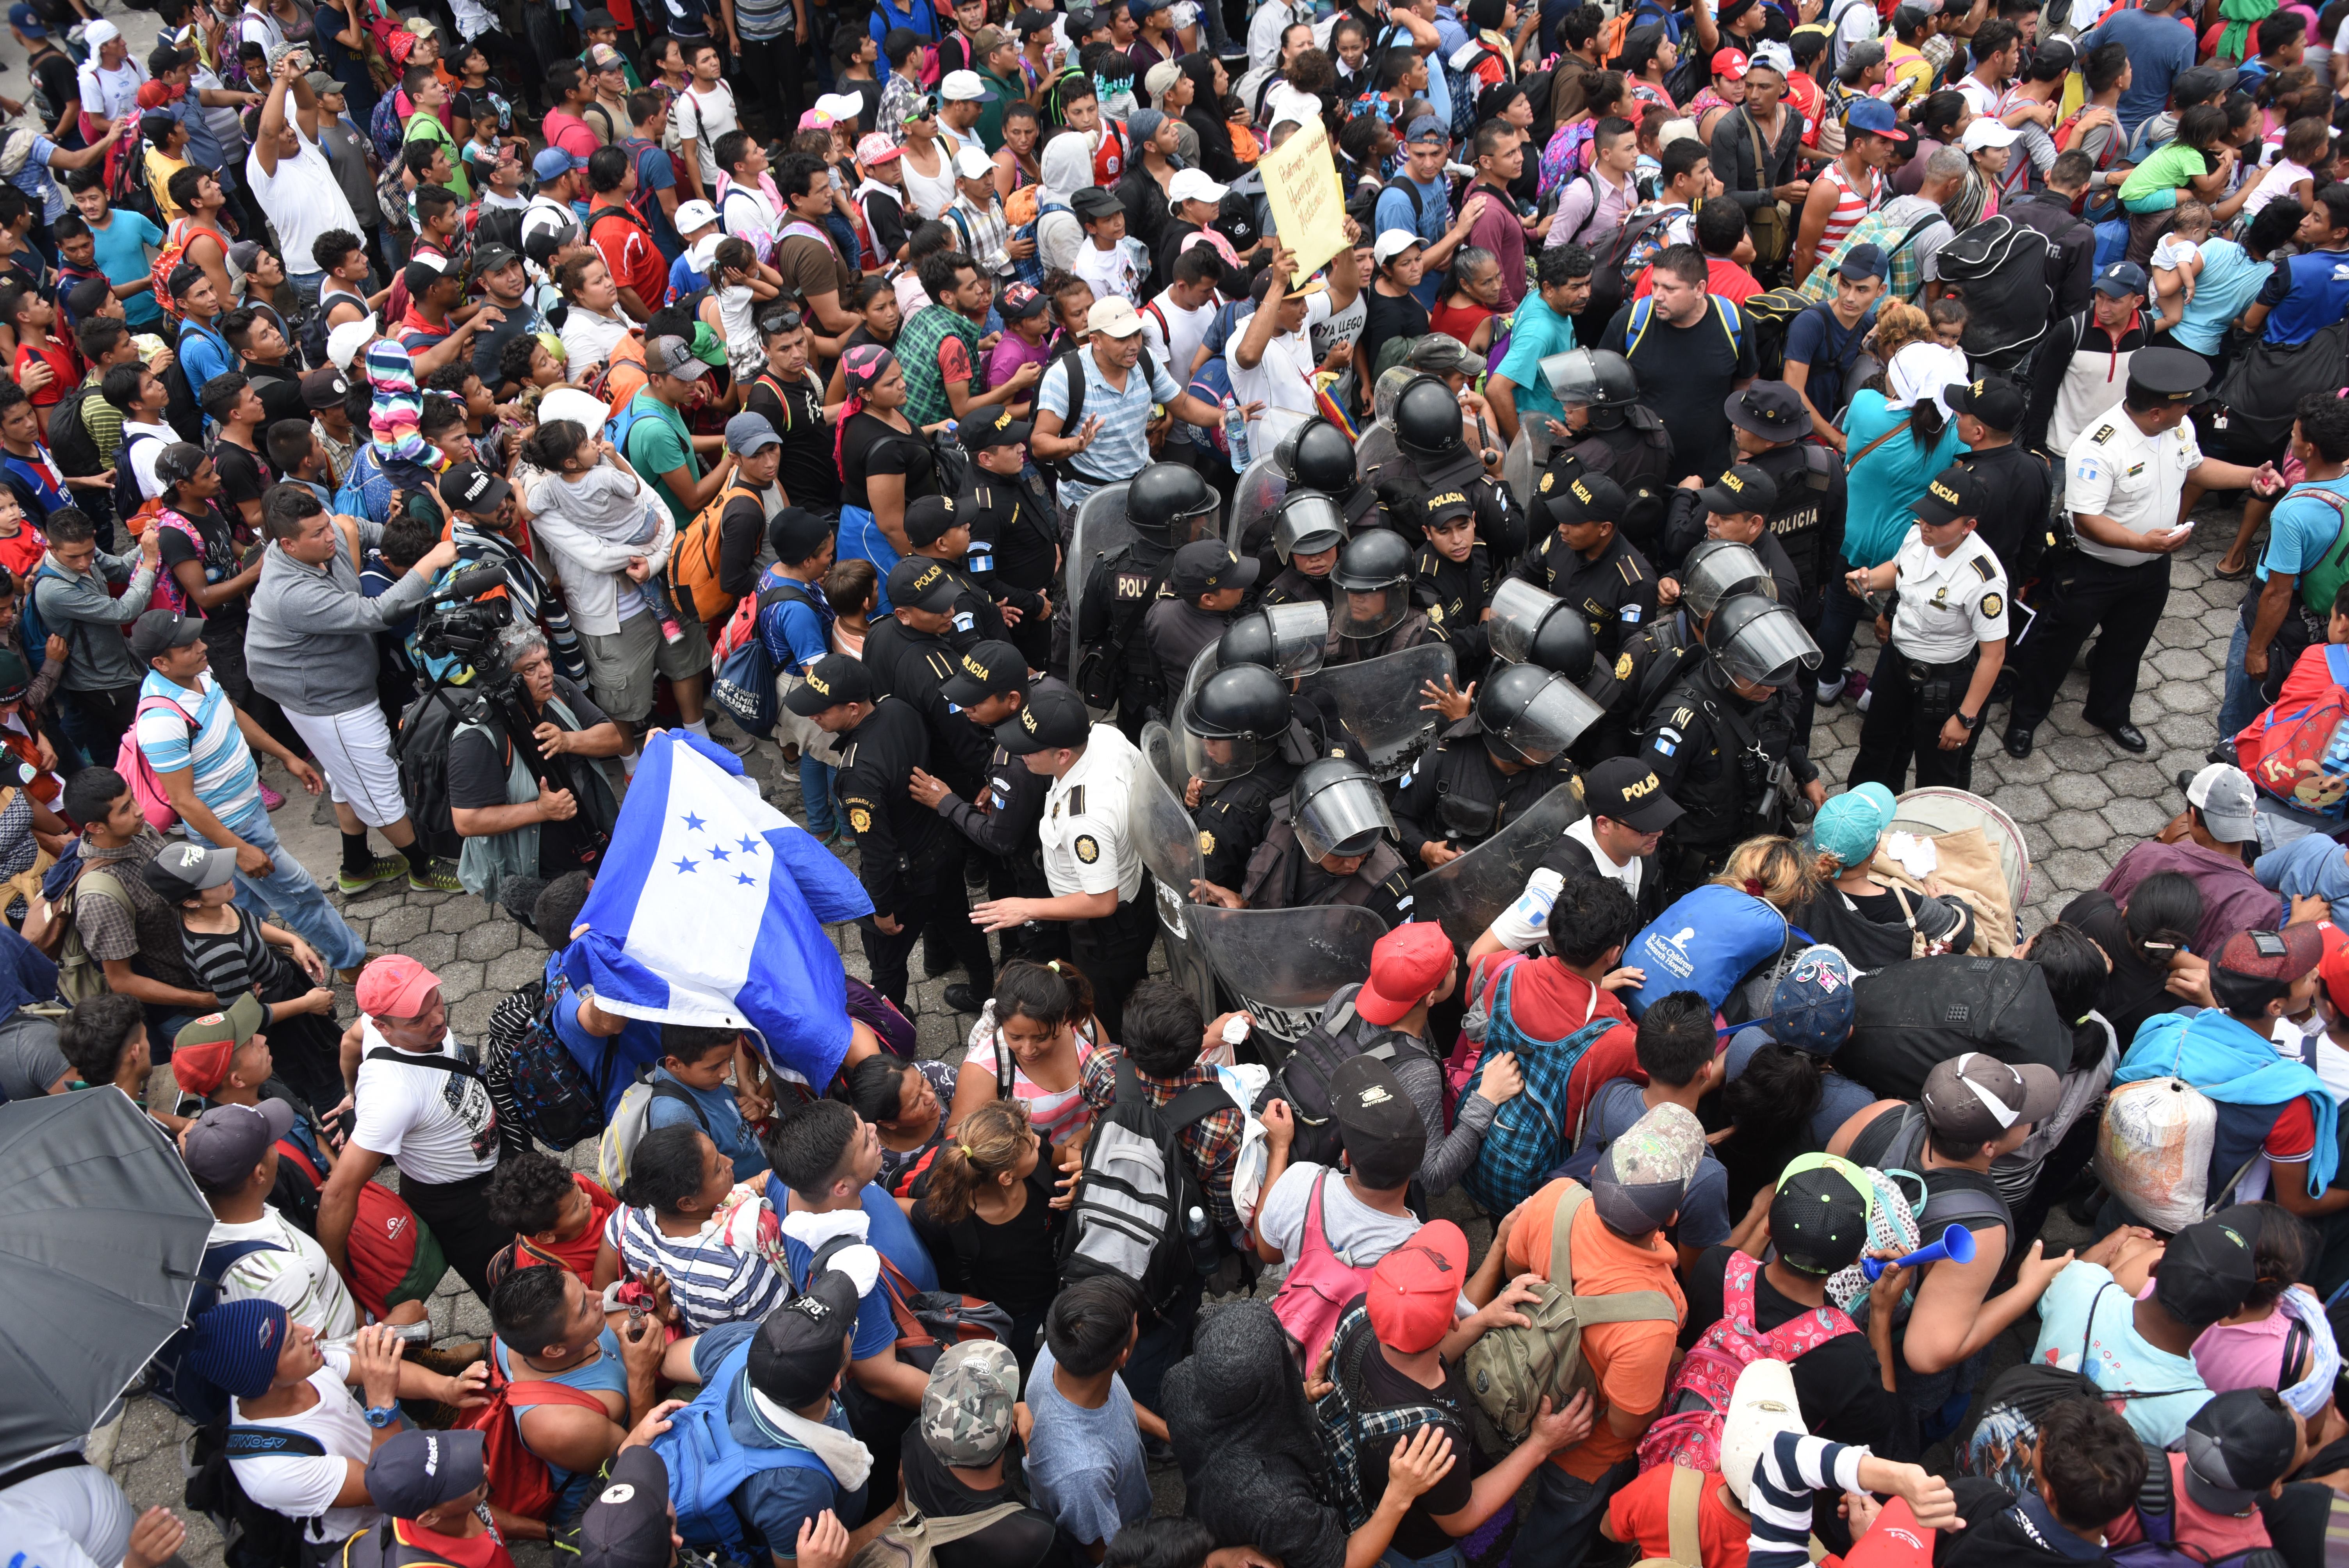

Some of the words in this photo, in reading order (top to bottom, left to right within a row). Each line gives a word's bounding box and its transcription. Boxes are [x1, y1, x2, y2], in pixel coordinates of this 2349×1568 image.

[1338, 315, 1362, 333] LLEGO
[465, 474, 489, 501] PUMA
[1428, 492, 1466, 511] POLICIA
[1770, 508, 1817, 535] POLICIA
[914, 564, 943, 591] POLICIA
[845, 797, 869, 807] COMISARIA
[869, 800, 875, 809] 42
[1645, 938, 1666, 961] Research
[1665, 957, 1691, 978] Hospital
[1649, 932, 1658, 943] St.
[1654, 938, 1667, 951] Jude
[1666, 949, 1694, 972] Children's
[795, 1297, 823, 1315] CAT
